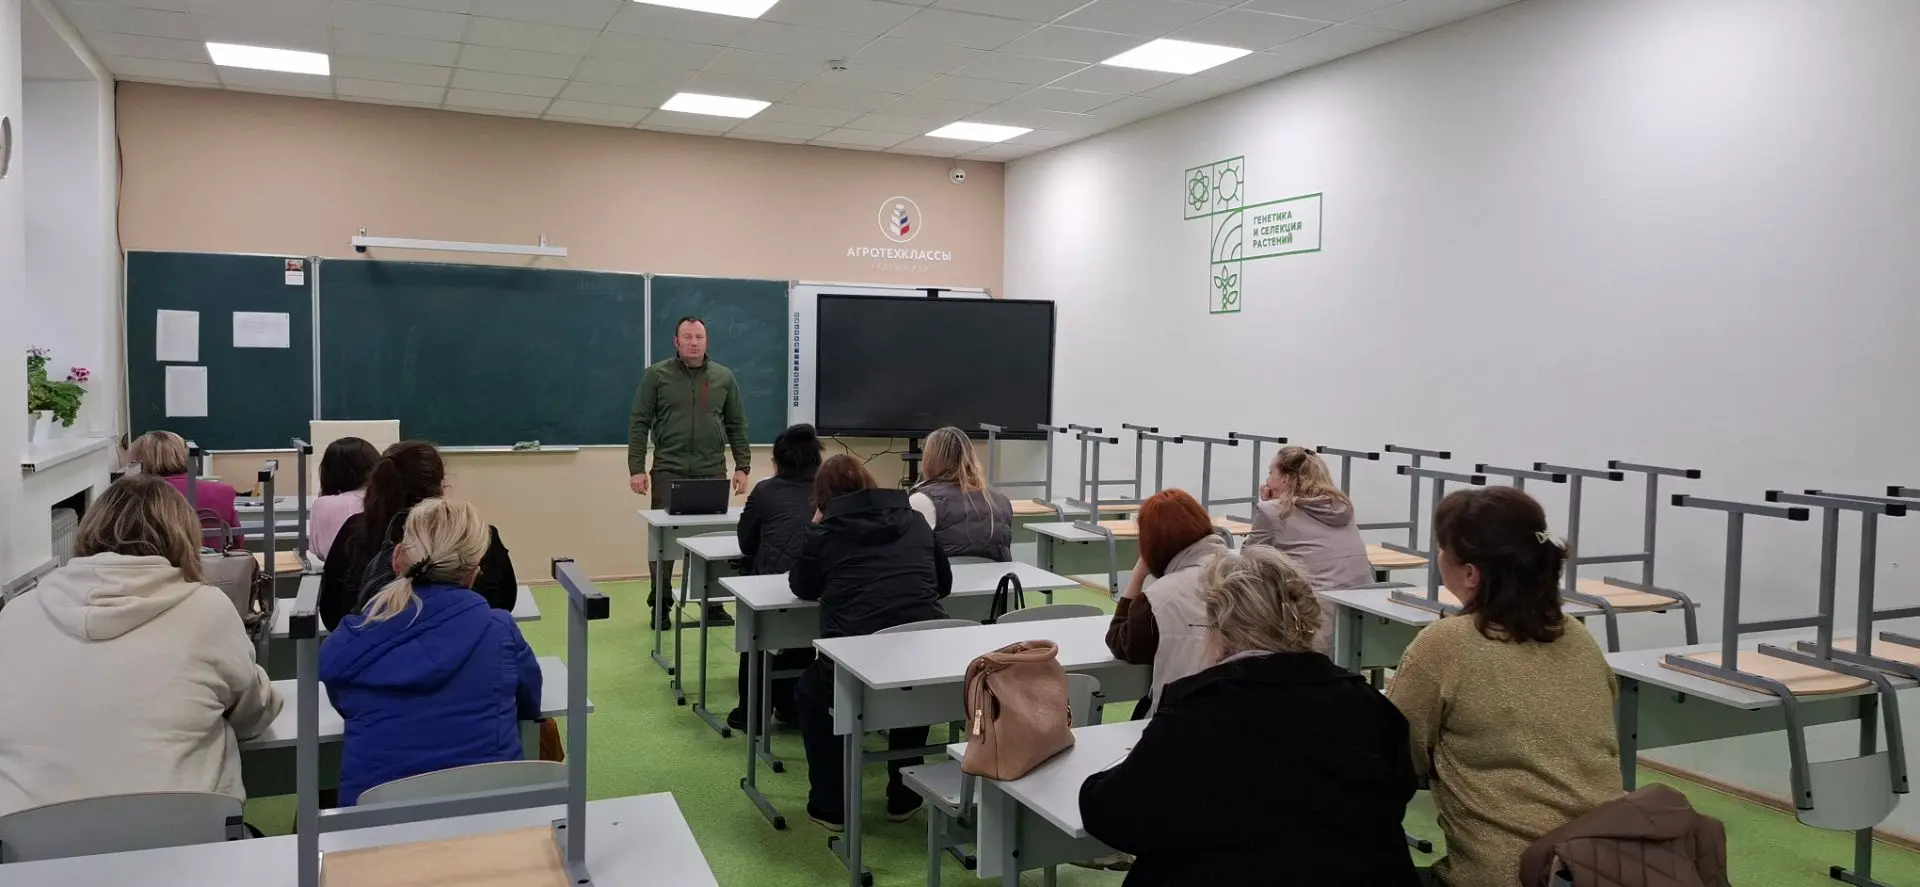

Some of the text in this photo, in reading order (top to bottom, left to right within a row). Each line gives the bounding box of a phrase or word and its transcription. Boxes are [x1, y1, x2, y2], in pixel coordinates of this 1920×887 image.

[1253, 210, 1292, 224] ГЕНЕТИКА
[1253, 221, 1302, 236] И СЕЛЕКЦИЯ
[1252, 233, 1293, 248] РАСТЕНИЙ
[847, 247, 952, 261] АГРОТЕХКЛАССЫ
